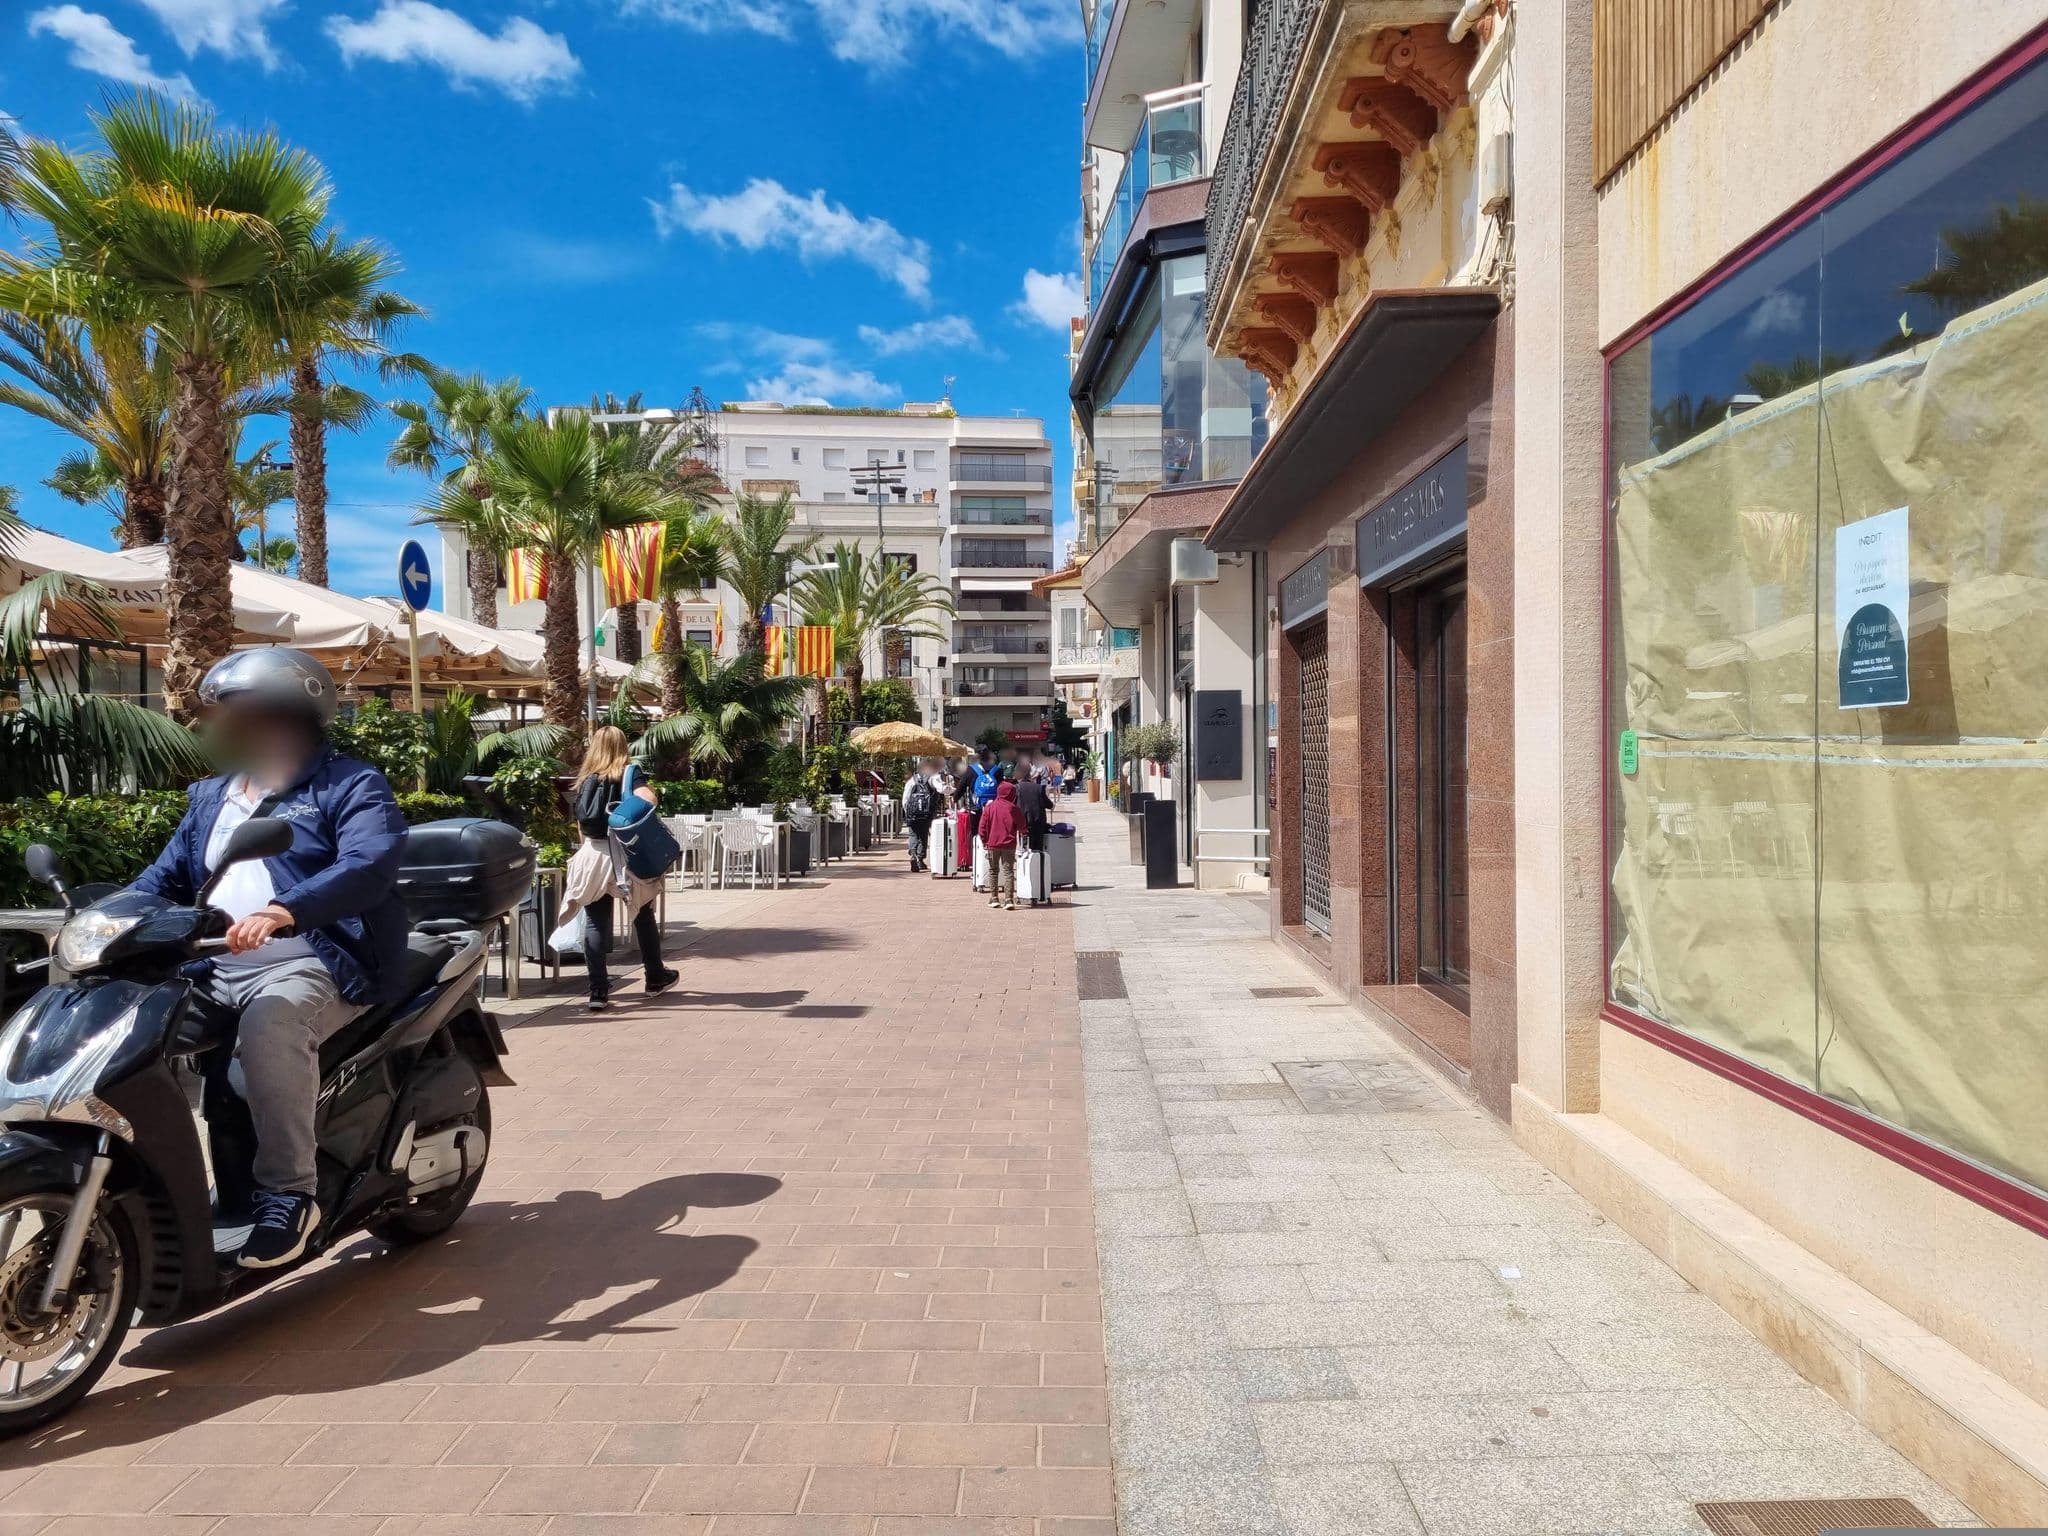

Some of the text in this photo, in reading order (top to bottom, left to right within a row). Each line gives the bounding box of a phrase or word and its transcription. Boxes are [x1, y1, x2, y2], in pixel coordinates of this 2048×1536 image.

[686, 615, 711, 623] DE LA
[1857, 635, 1887, 653] Personal
